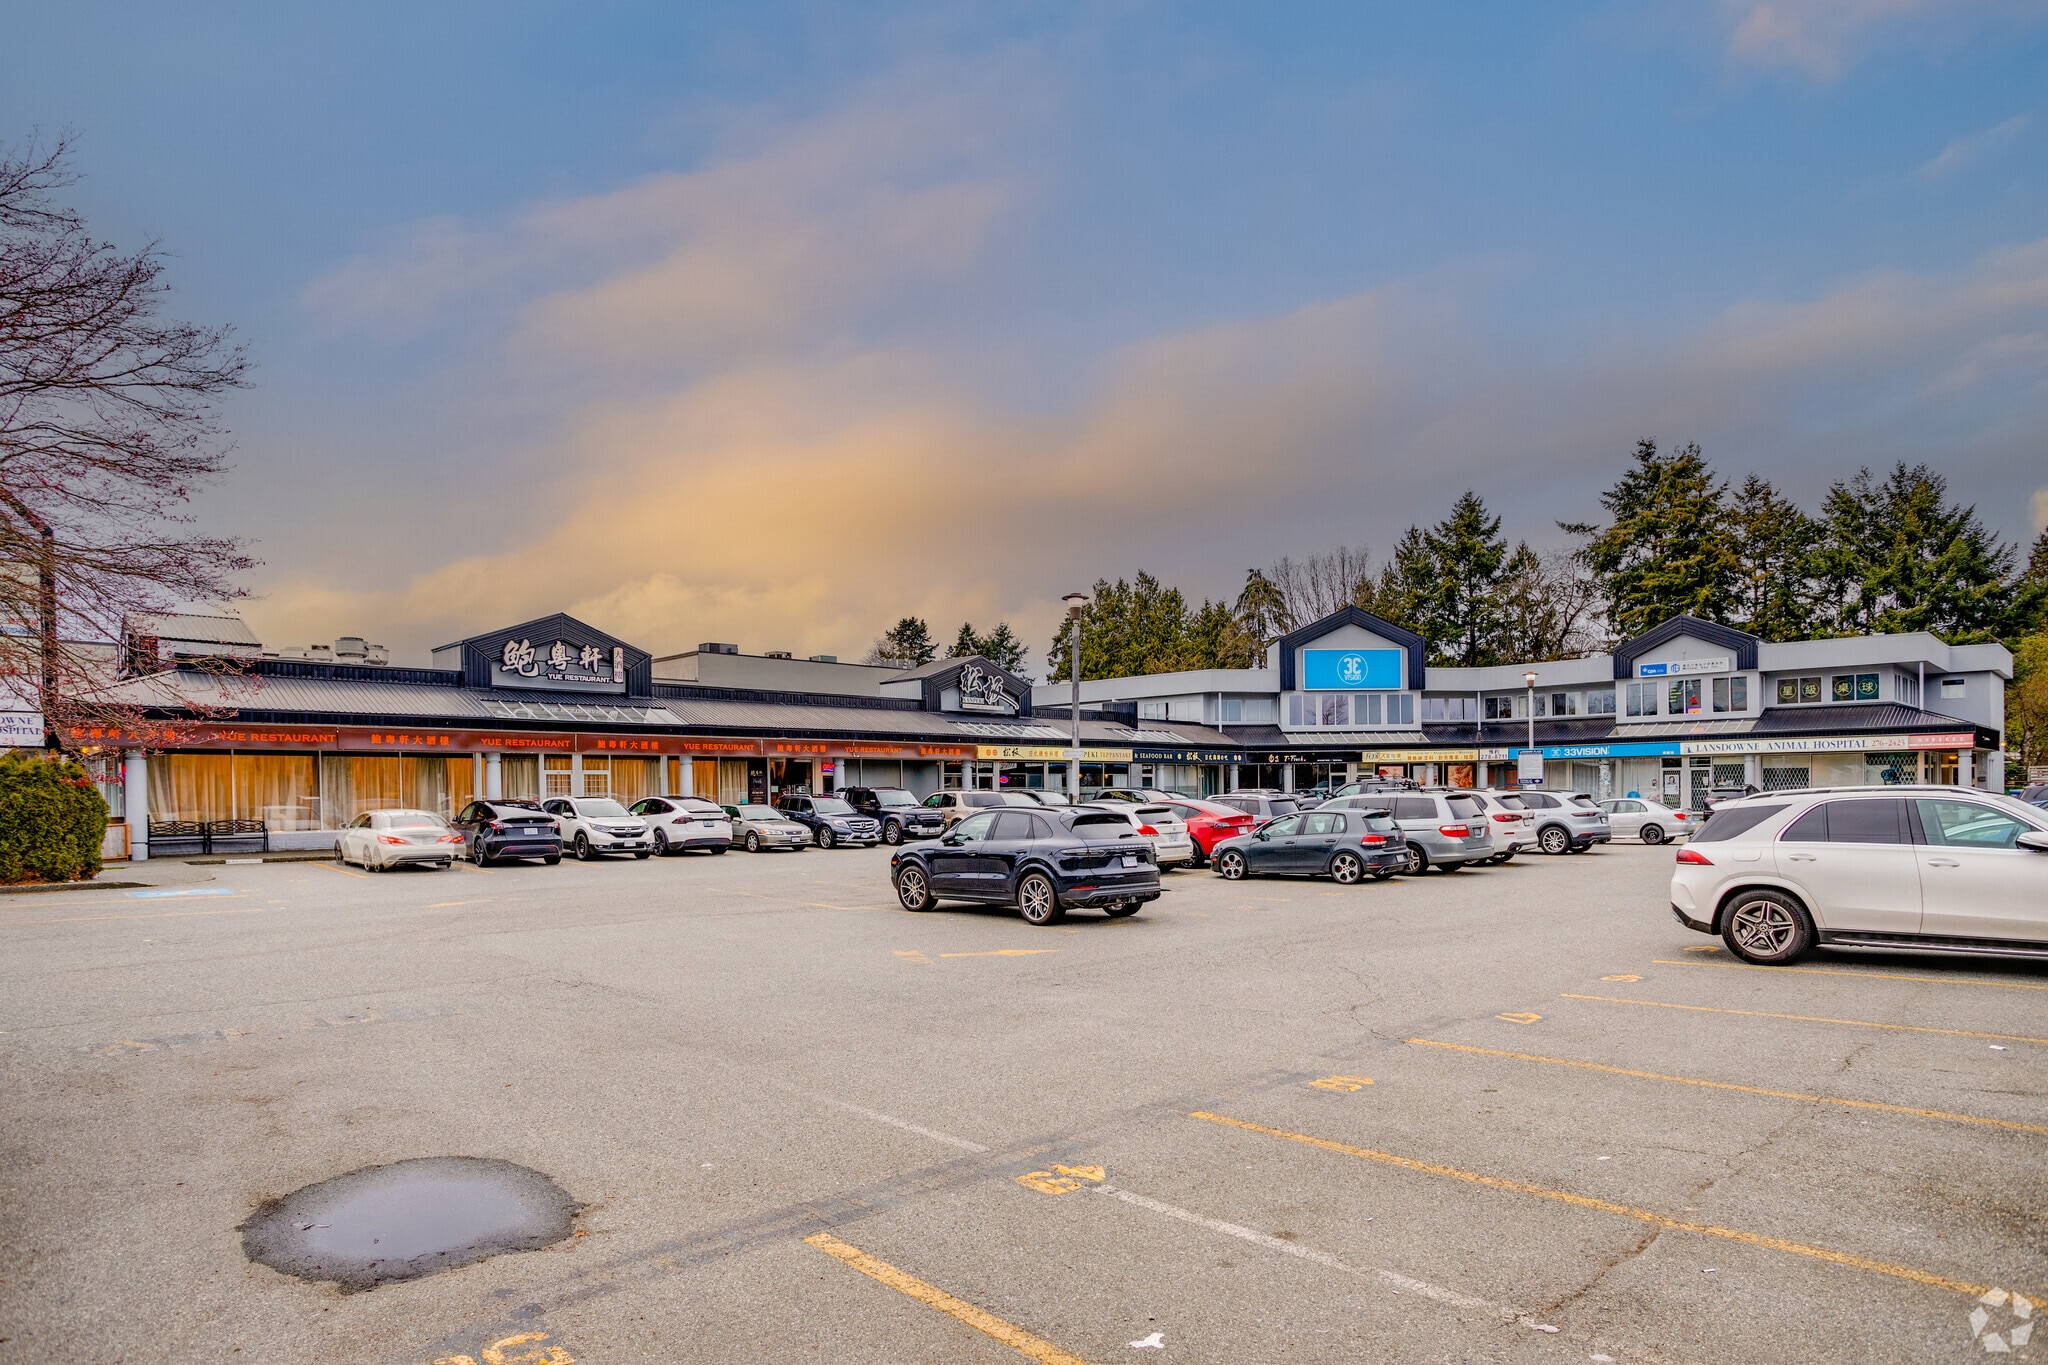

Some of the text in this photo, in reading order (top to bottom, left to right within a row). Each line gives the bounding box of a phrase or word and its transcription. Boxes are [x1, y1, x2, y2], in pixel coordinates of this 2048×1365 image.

[564, 675, 611, 684] RESTAURANT
[0, 727, 42, 735] SPITAL
[219, 732, 337, 743] YUE RESTAURANT
[481, 738, 571, 747] YUE RESTAURANT
[1696, 742, 1760, 753] LANSDOWNE
[1767, 741, 1809, 751] ANIMAL
[1813, 739, 1868, 750] HOSPITAL
[1564, 747, 1608, 757] 33VISION
[1015, 1163, 1106, 1195] 49
